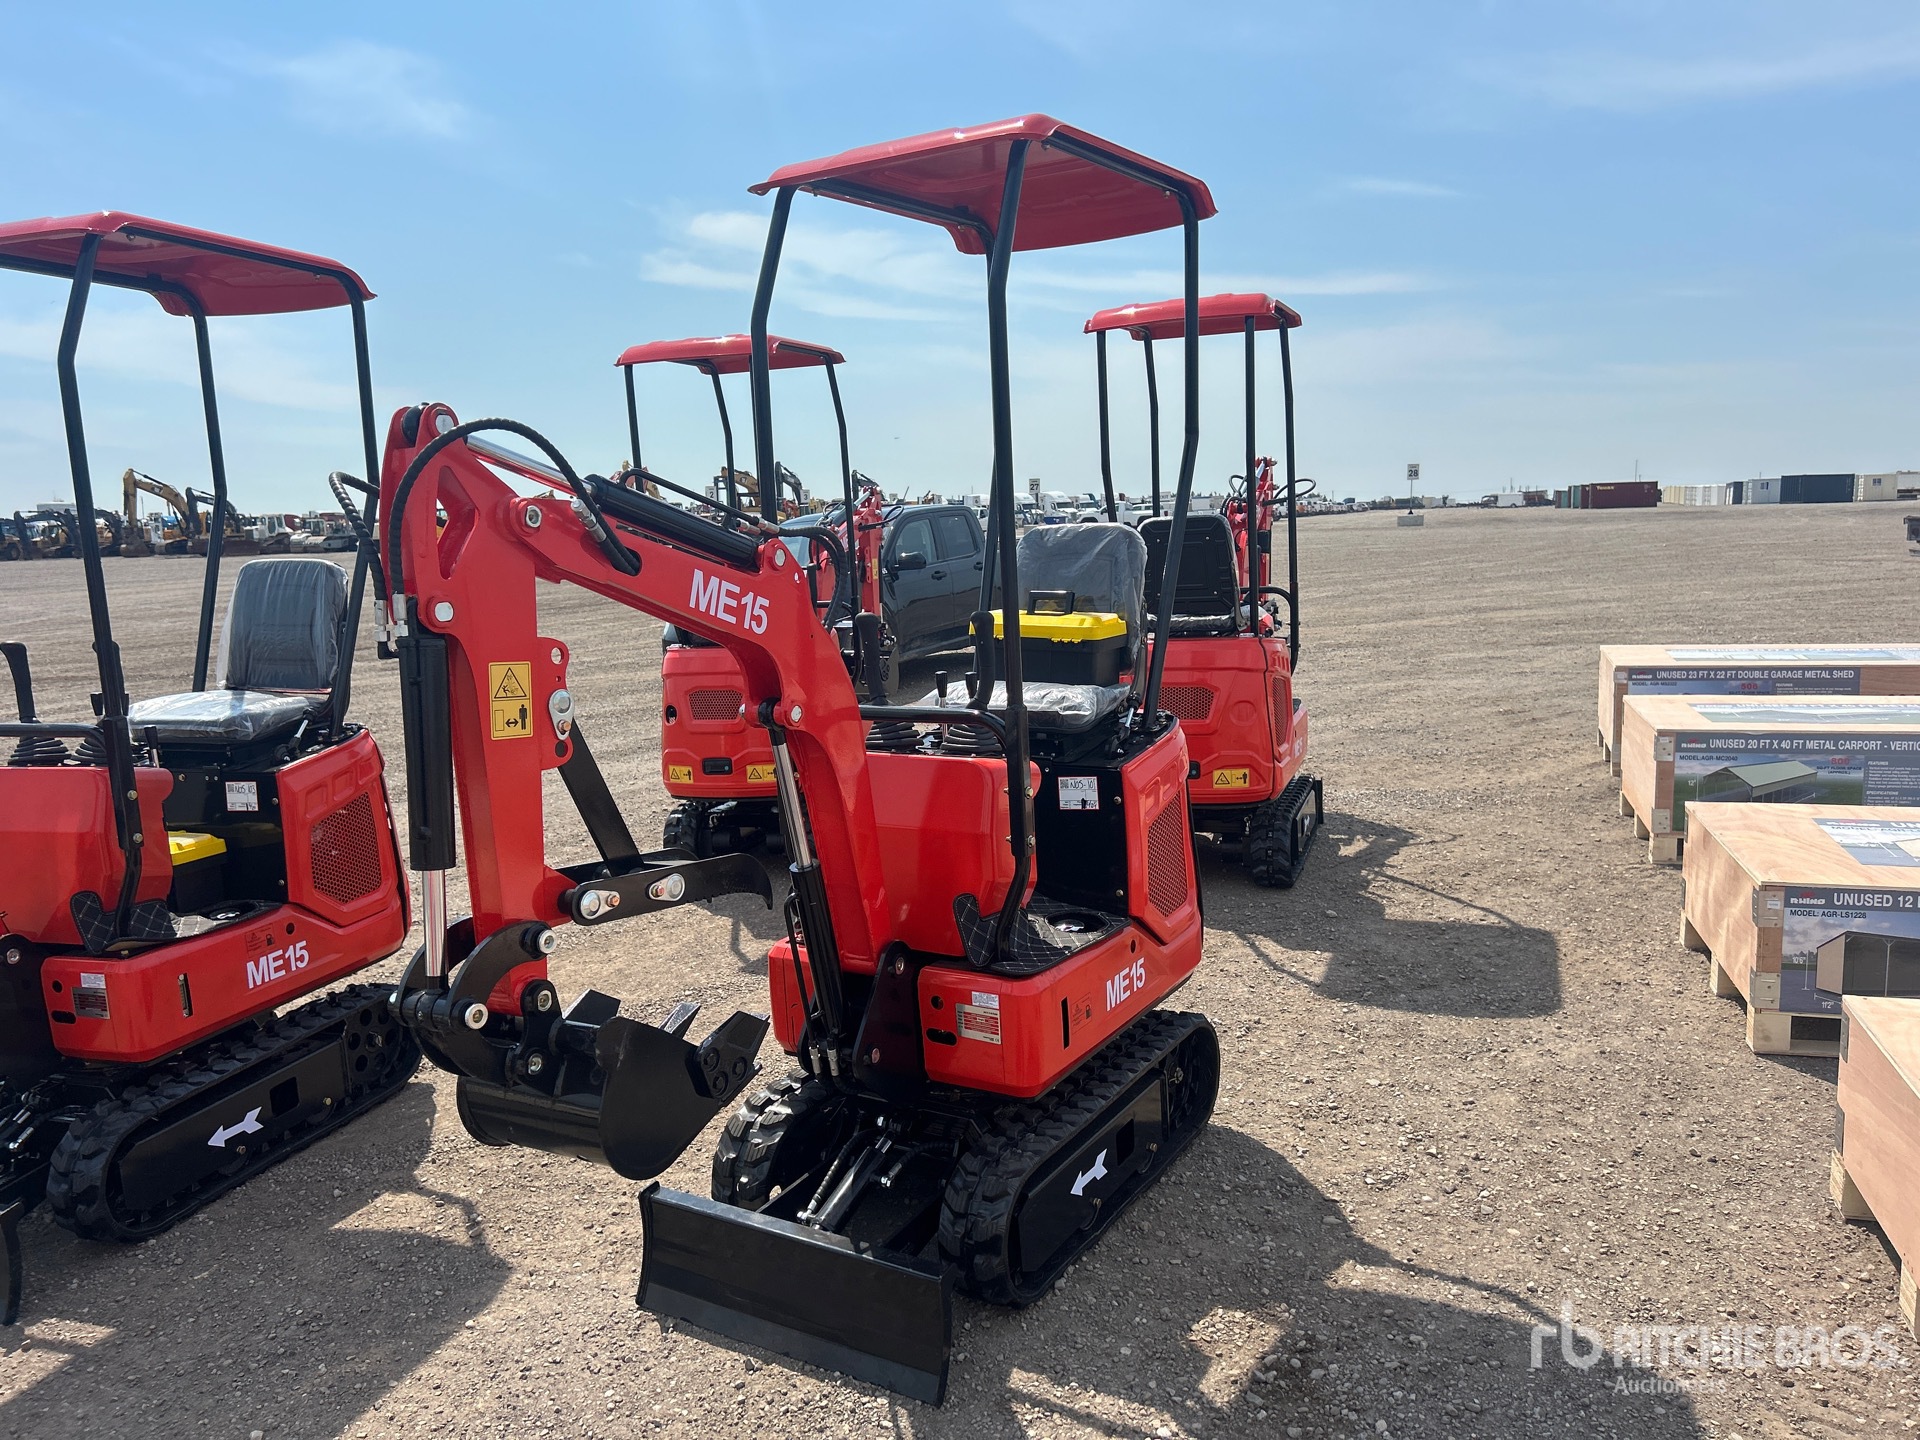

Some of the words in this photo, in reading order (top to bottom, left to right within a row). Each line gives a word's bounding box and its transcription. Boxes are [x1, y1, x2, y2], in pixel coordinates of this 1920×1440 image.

[1409, 469, 1419, 477] 28
[1030, 483, 1039, 491] 27
[689, 568, 770, 635] ME15
[1656, 670, 1687, 679] UNUSED
[1688, 670, 1697, 679] 23
[1699, 670, 1708, 679] FT
[1709, 670, 1715, 679] X
[1716, 670, 1725, 679] 22
[1726, 670, 1736, 679] FT
[1737, 670, 1769, 679] DOUBLE
[1771, 670, 1803, 679] GARAGE
[1804, 670, 1831, 679] METAL
[1832, 670, 1855, 679] SHED
[1709, 739, 1746, 749] UNUSED
[1747, 739, 1758, 749] 20
[1759, 740, 1770, 749] FT
[1772, 740, 1779, 749] X
[1780, 740, 1791, 749] 40
[1792, 740, 1804, 749] FT
[1805, 740, 1836, 750] METAL
[1838, 740, 1882, 751] CARPORT
[1790, 897, 1826, 905] RHINO
[1833, 892, 1893, 907] UNUSED
[1897, 895, 1913, 908] 12
[1789, 909, 1819, 917] MODEL:
[1820, 910, 1867, 919] AGR-LS1228
[246, 940, 309, 989] ME15
[1106, 957, 1146, 1012] ME15
